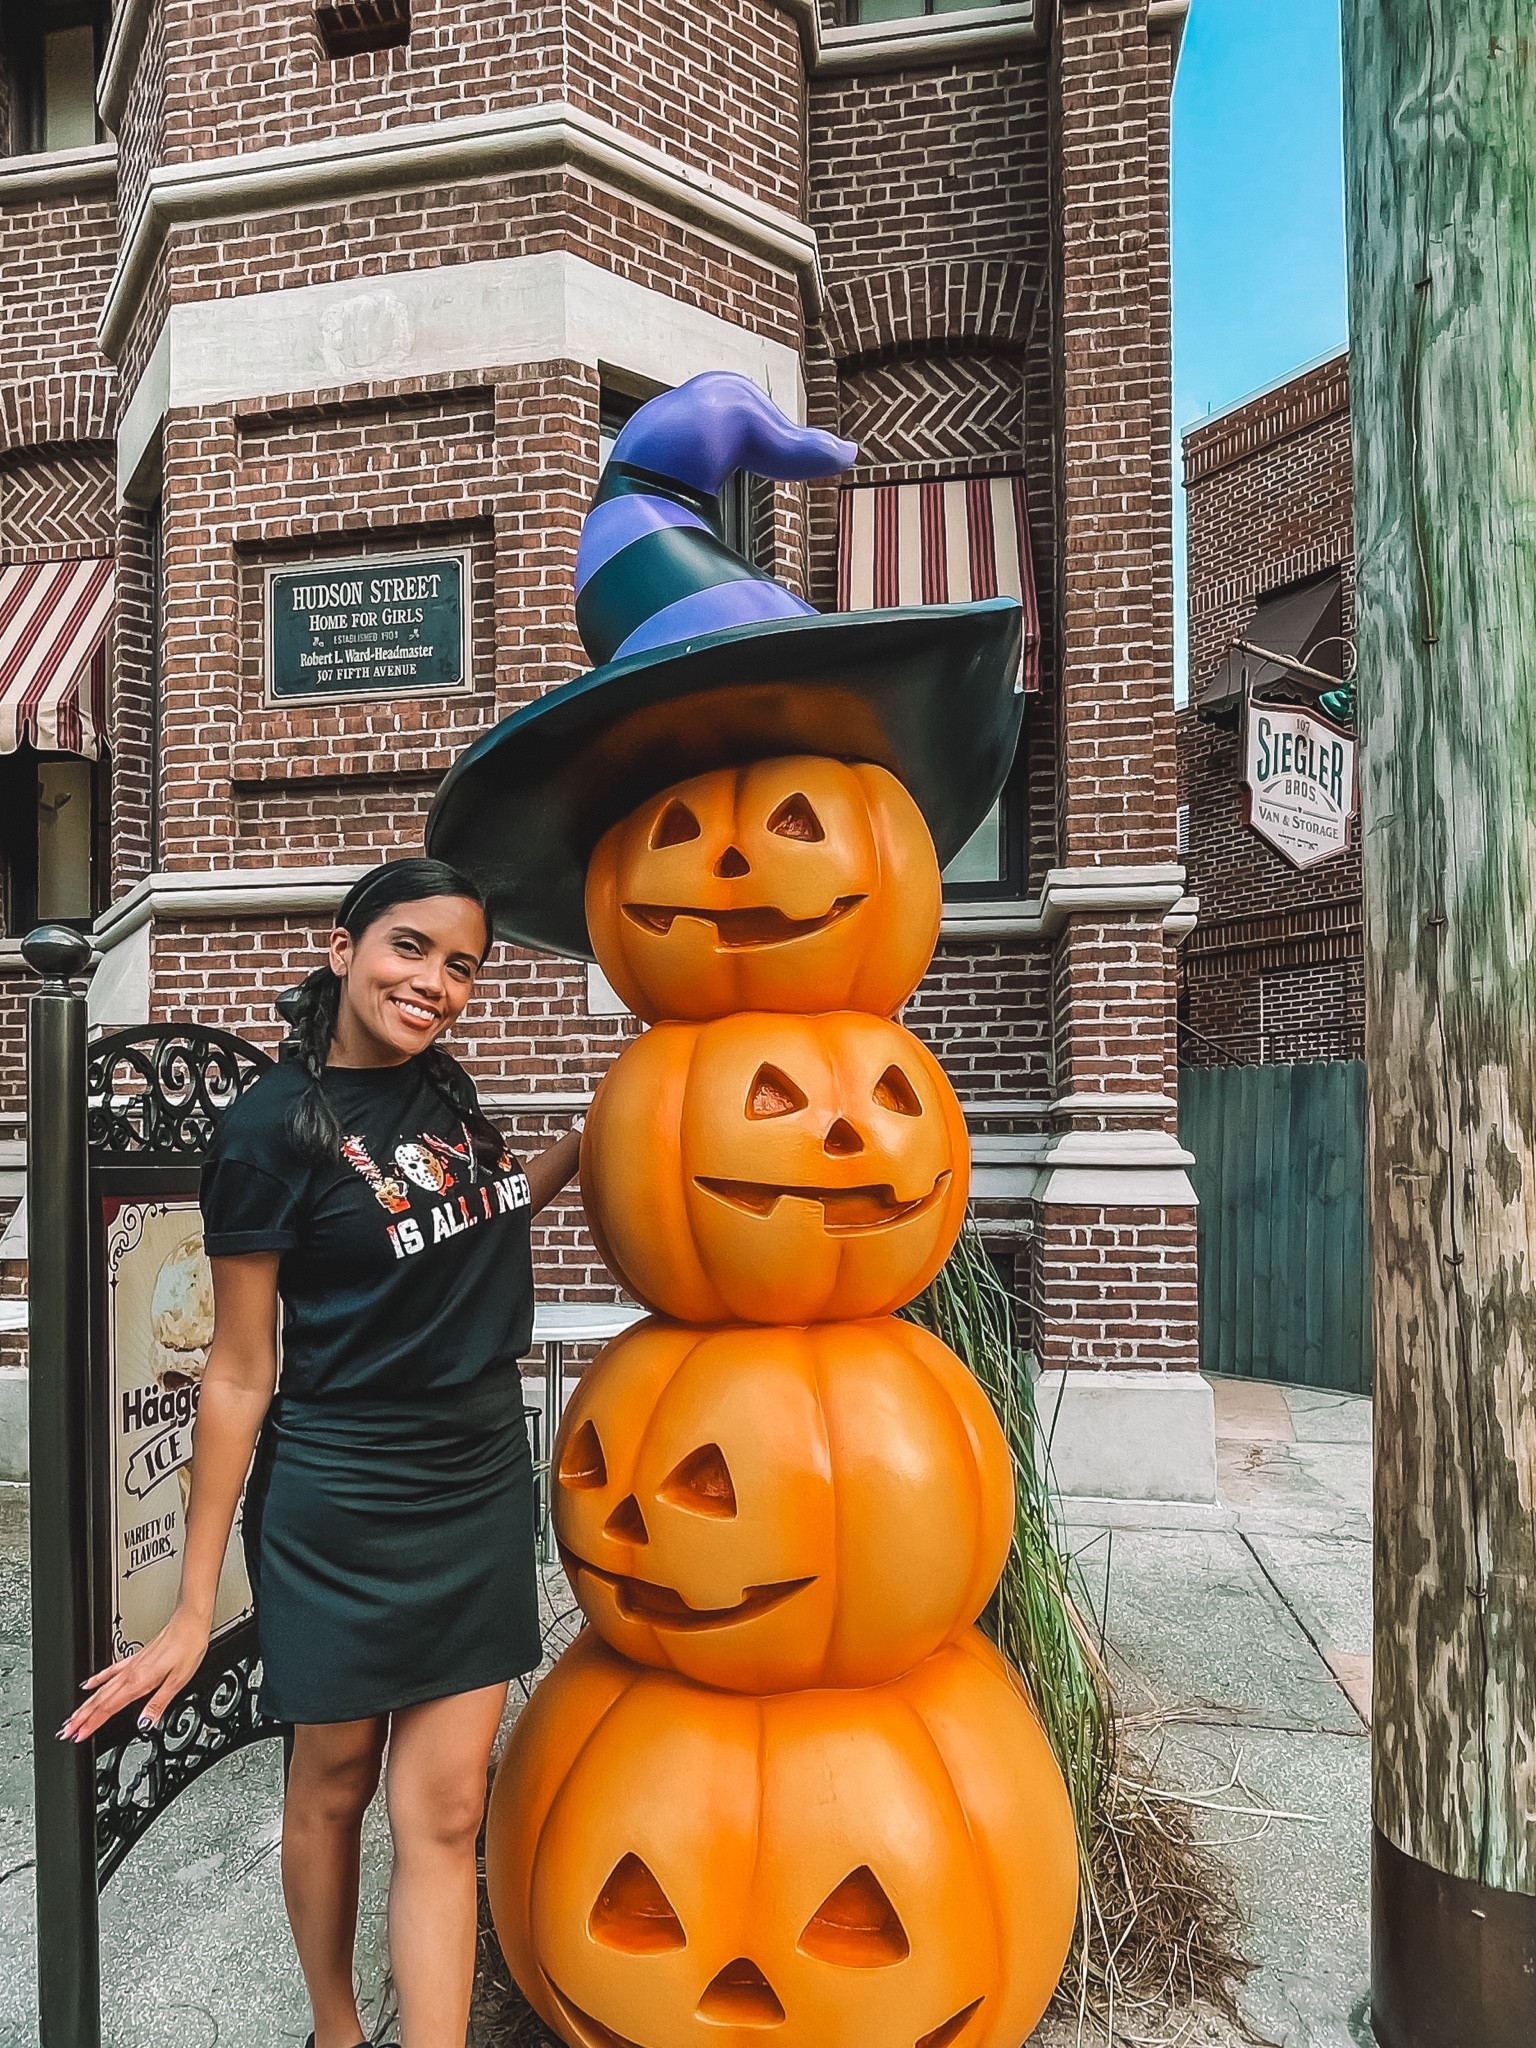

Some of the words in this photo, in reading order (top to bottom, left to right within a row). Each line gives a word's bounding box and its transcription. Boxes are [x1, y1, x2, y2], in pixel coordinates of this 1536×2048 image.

[292, 582, 363, 611] HUDSON
[370, 574, 441, 604] STREET
[309, 614, 348, 631] HOME
[351, 612, 378, 628] FOR
[382, 608, 424, 625] GIRLS
[333, 632, 378, 645] ESTABLISHED
[300, 651, 333, 667] Robert
[334, 650, 343, 664] L.
[336, 667, 370, 680] FIFTH
[373, 663, 417, 677] AVENUE
[1257, 717, 1343, 812] SIEGLER
[1285, 779, 1318, 804] BROS.
[1258, 805, 1280, 824] VAN
[1282, 814, 1290, 826] &
[1292, 815, 1339, 839] STORAGE
[386, 1217, 425, 1259] IS
[430, 1196, 478, 1244] ALL
[479, 1186, 492, 1219] I
[144, 1430, 182, 1482] ICE
[124, 1517, 161, 1549] VARIETY
[164, 1510, 176, 1531] OF
[131, 1533, 171, 1568] FLAVORS
